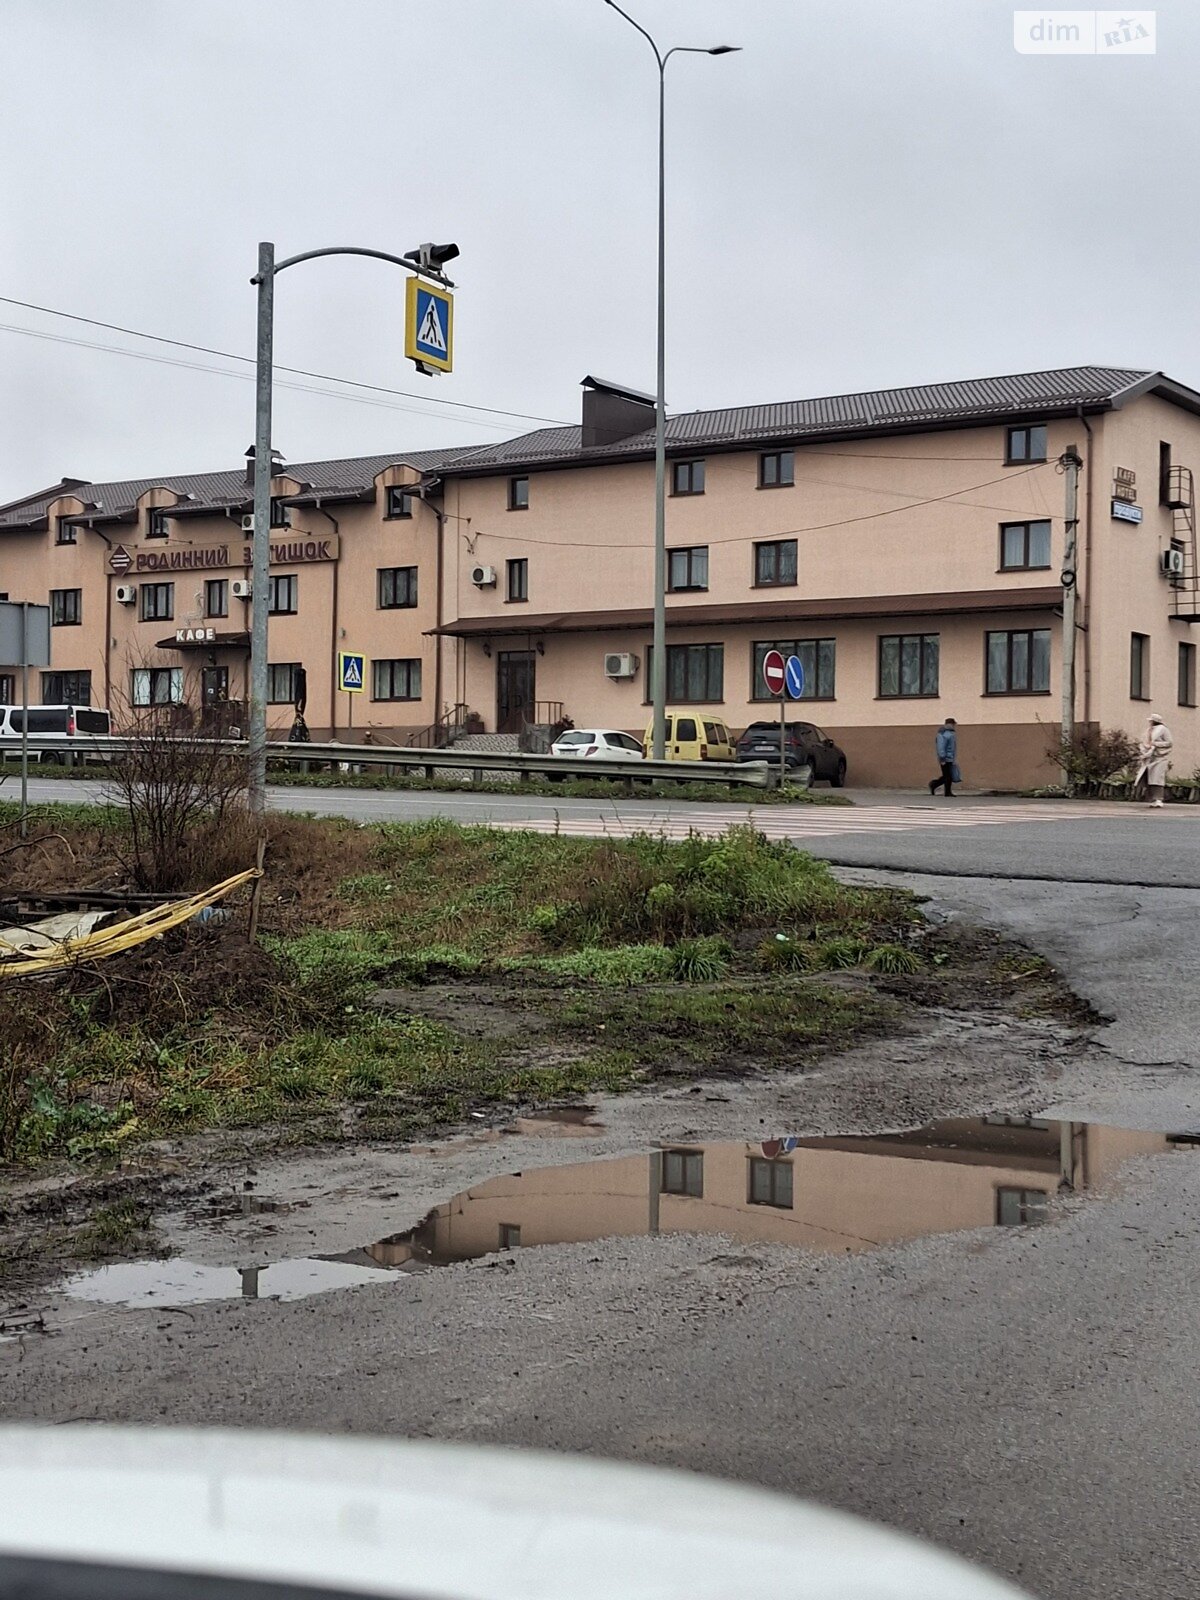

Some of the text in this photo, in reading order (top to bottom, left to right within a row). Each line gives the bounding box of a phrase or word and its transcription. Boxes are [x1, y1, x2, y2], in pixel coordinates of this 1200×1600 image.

[1117, 485, 1136, 500] HOTEL
[136, 545, 230, 571] РОДИННИЙ
[243, 541, 331, 565] ЗИШОК
[176, 628, 214, 642] КАФЕ
